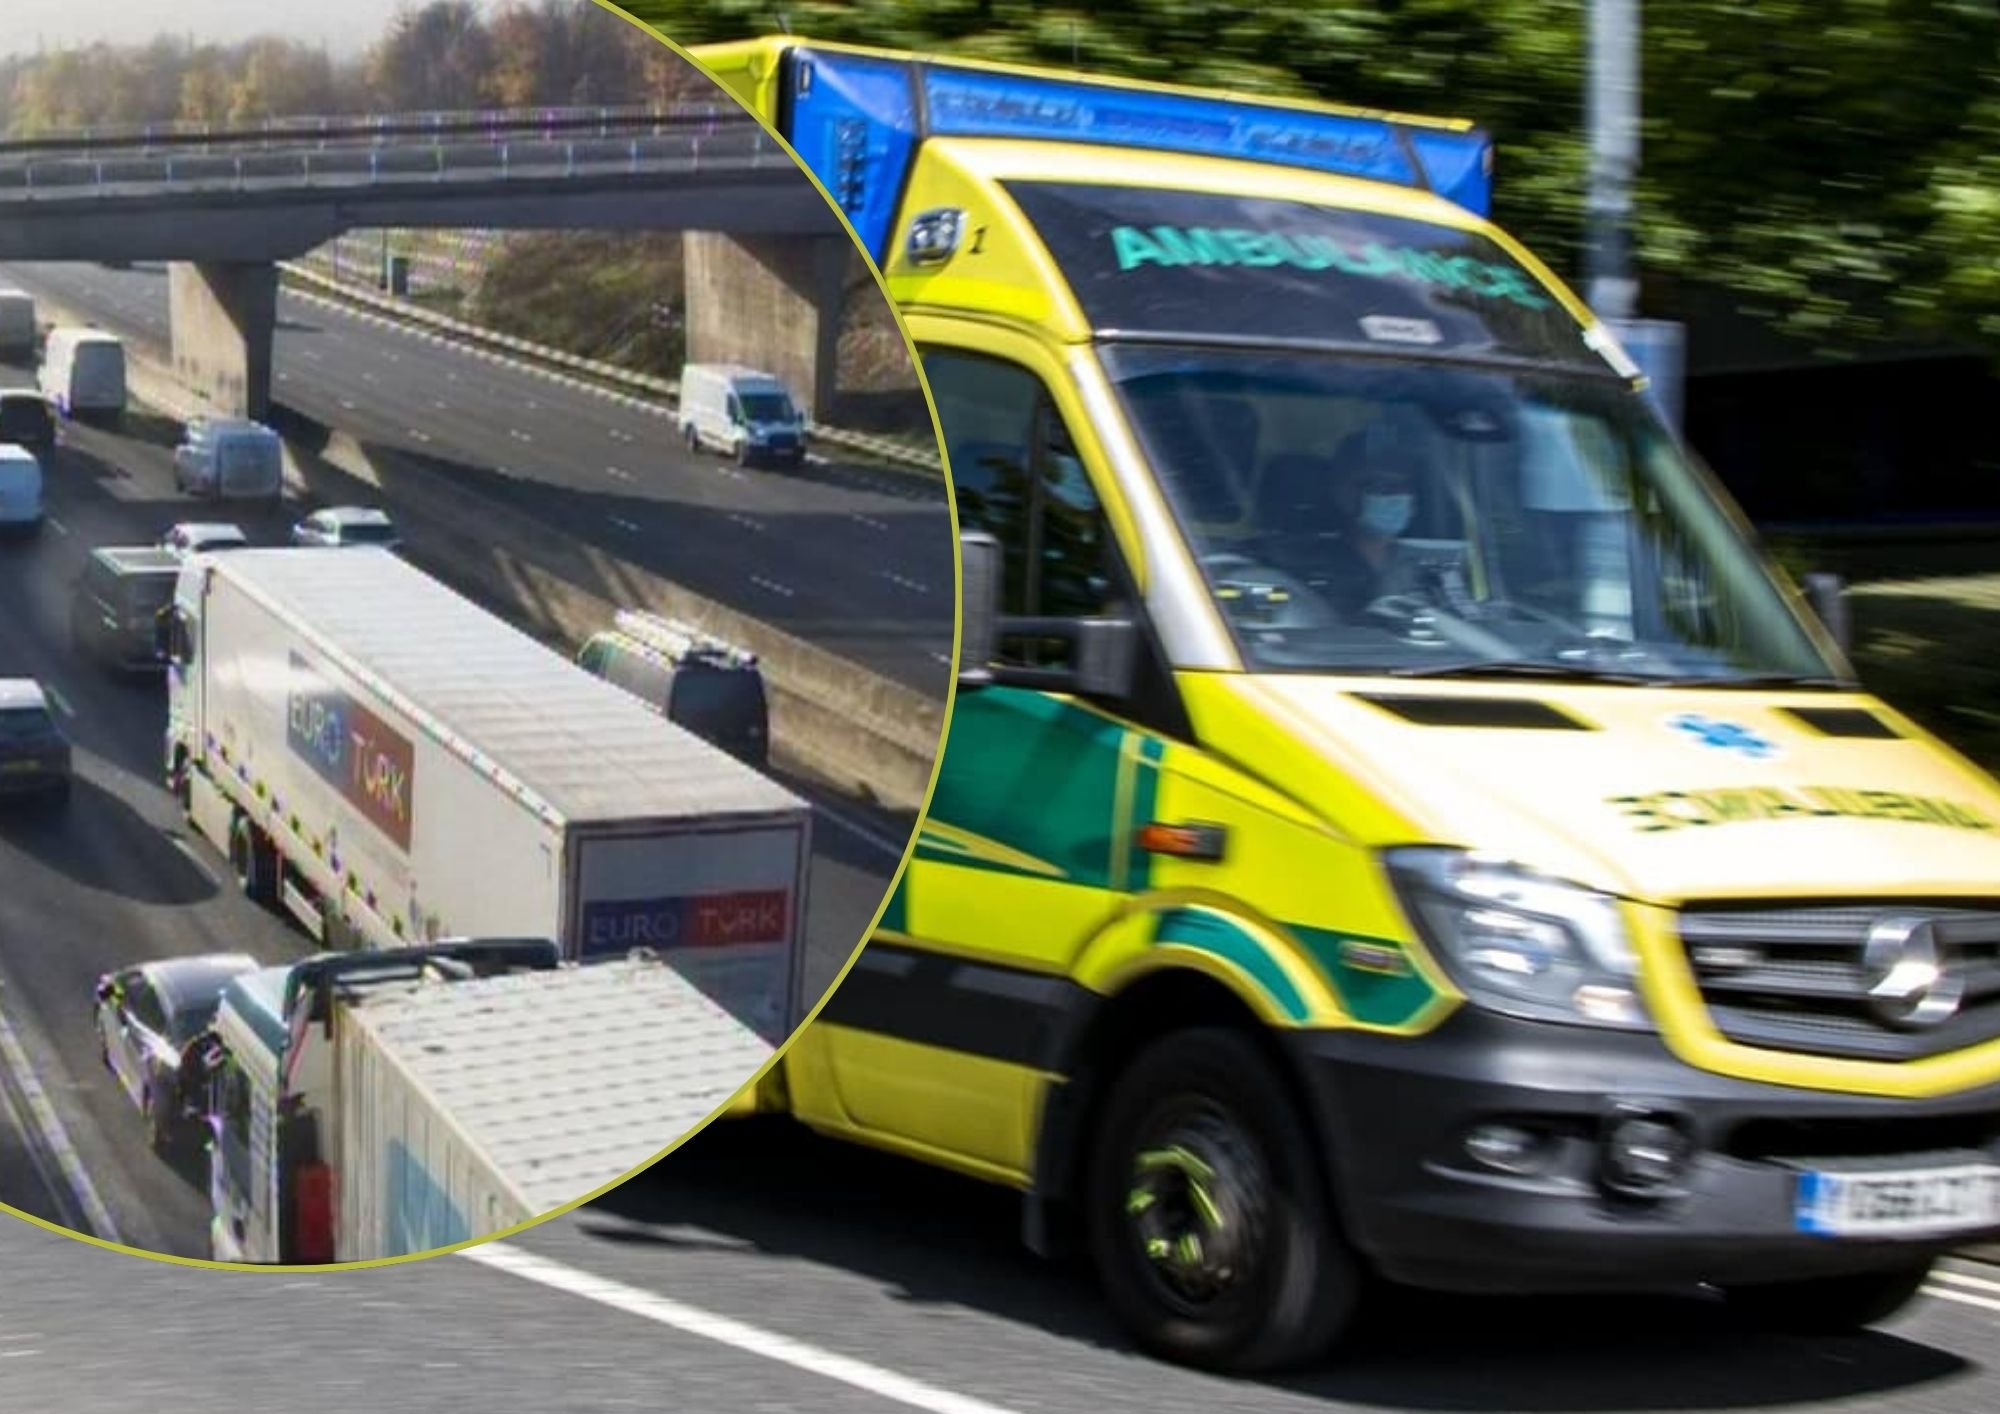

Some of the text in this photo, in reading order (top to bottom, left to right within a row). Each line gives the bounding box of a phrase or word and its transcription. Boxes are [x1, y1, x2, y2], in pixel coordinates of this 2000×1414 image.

[967, 223, 989, 254] 1
[1111, 225, 1549, 310] AMBULANCE
[289, 690, 344, 762] EURO
[590, 912, 678, 944] EURO
